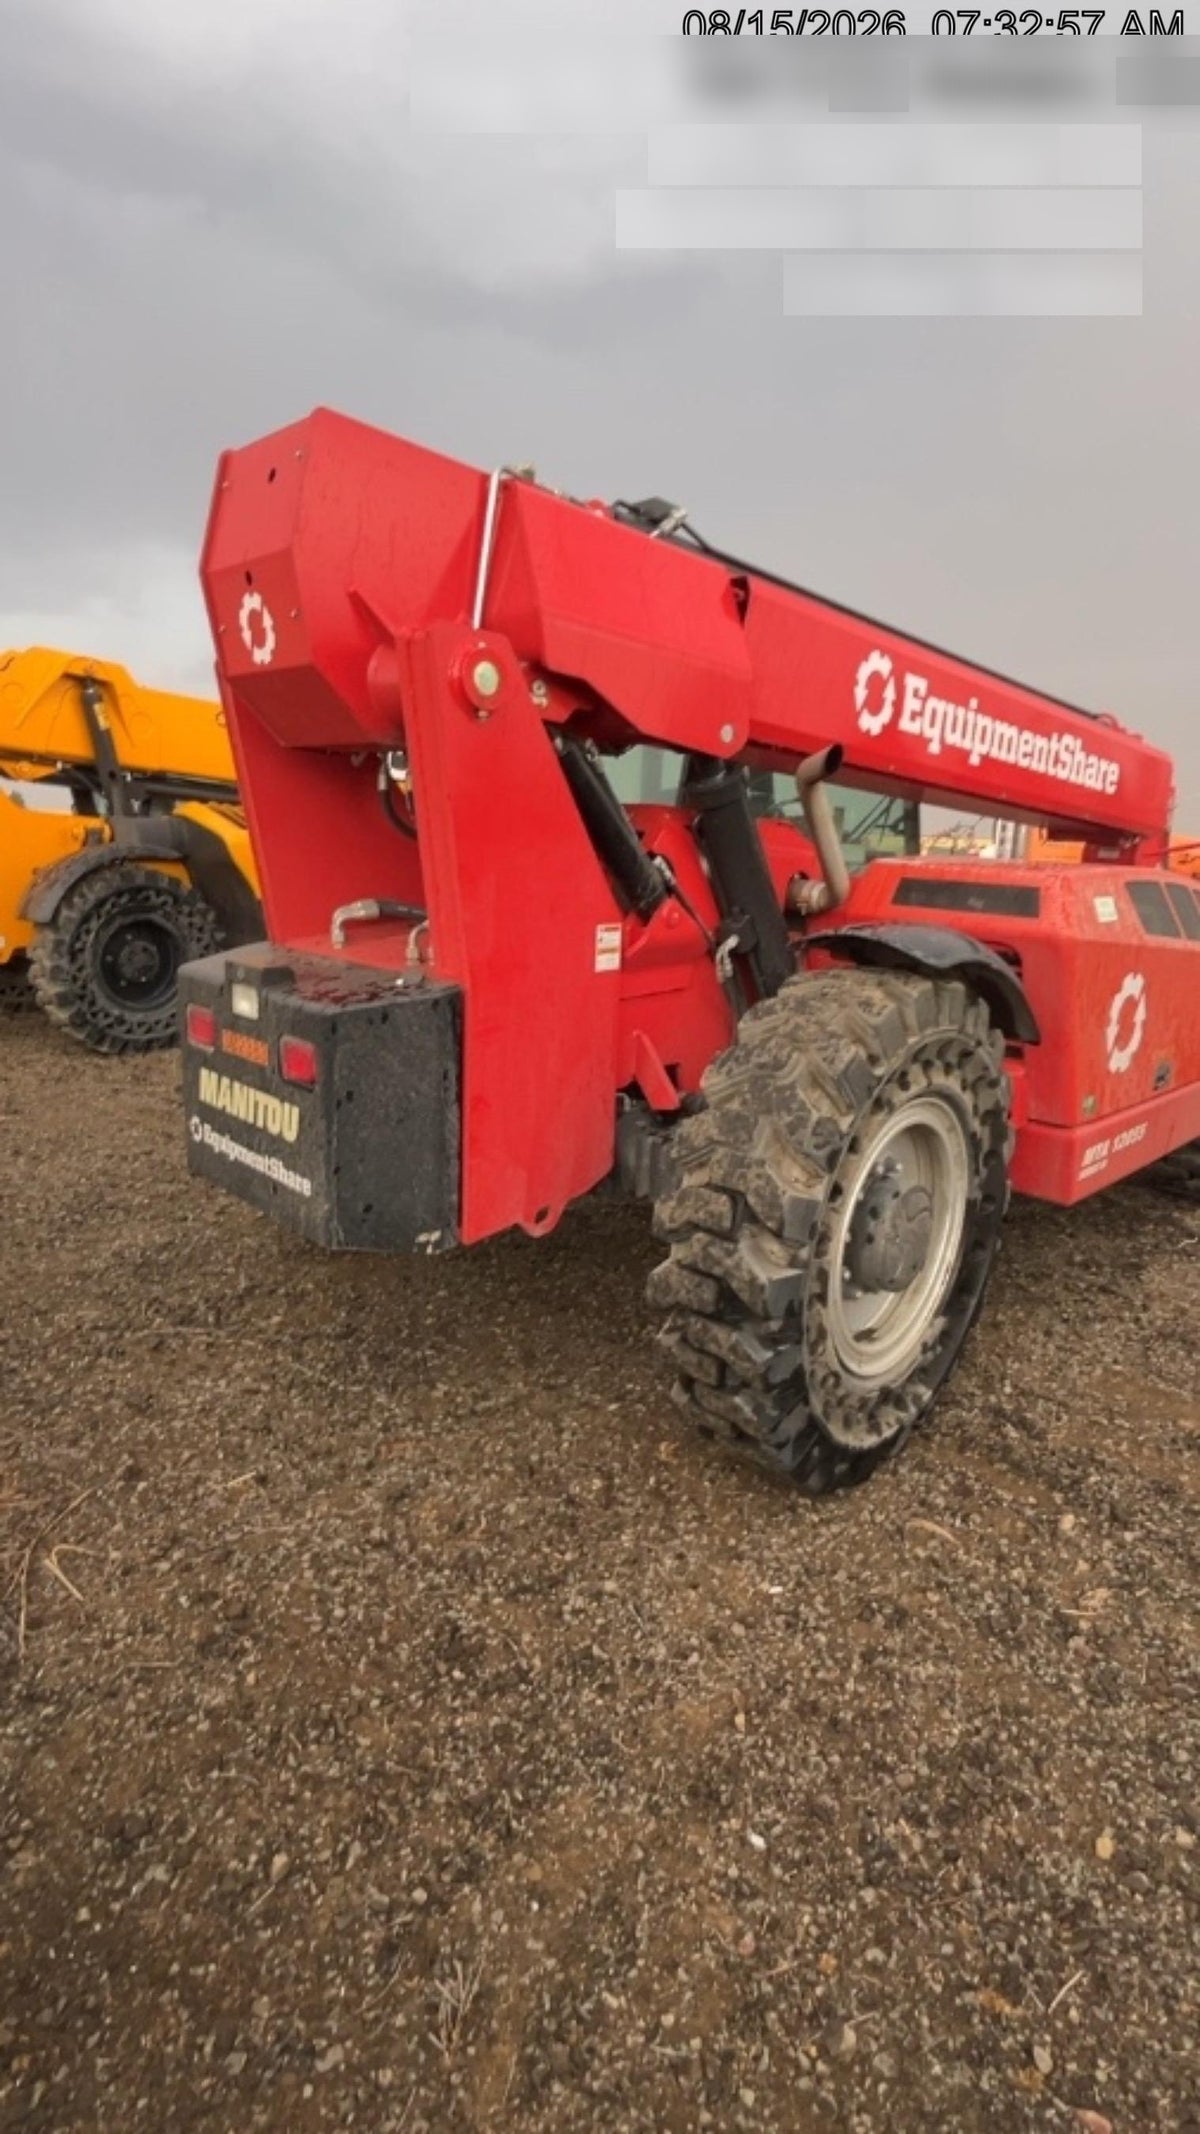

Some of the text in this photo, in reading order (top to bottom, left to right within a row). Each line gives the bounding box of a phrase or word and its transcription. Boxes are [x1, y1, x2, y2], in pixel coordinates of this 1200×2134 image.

[898, 672, 1121, 795] EquipmentShare
[199, 1066, 300, 1142] MANITOU
[203, 1123, 312, 1197] EquipmentShare
